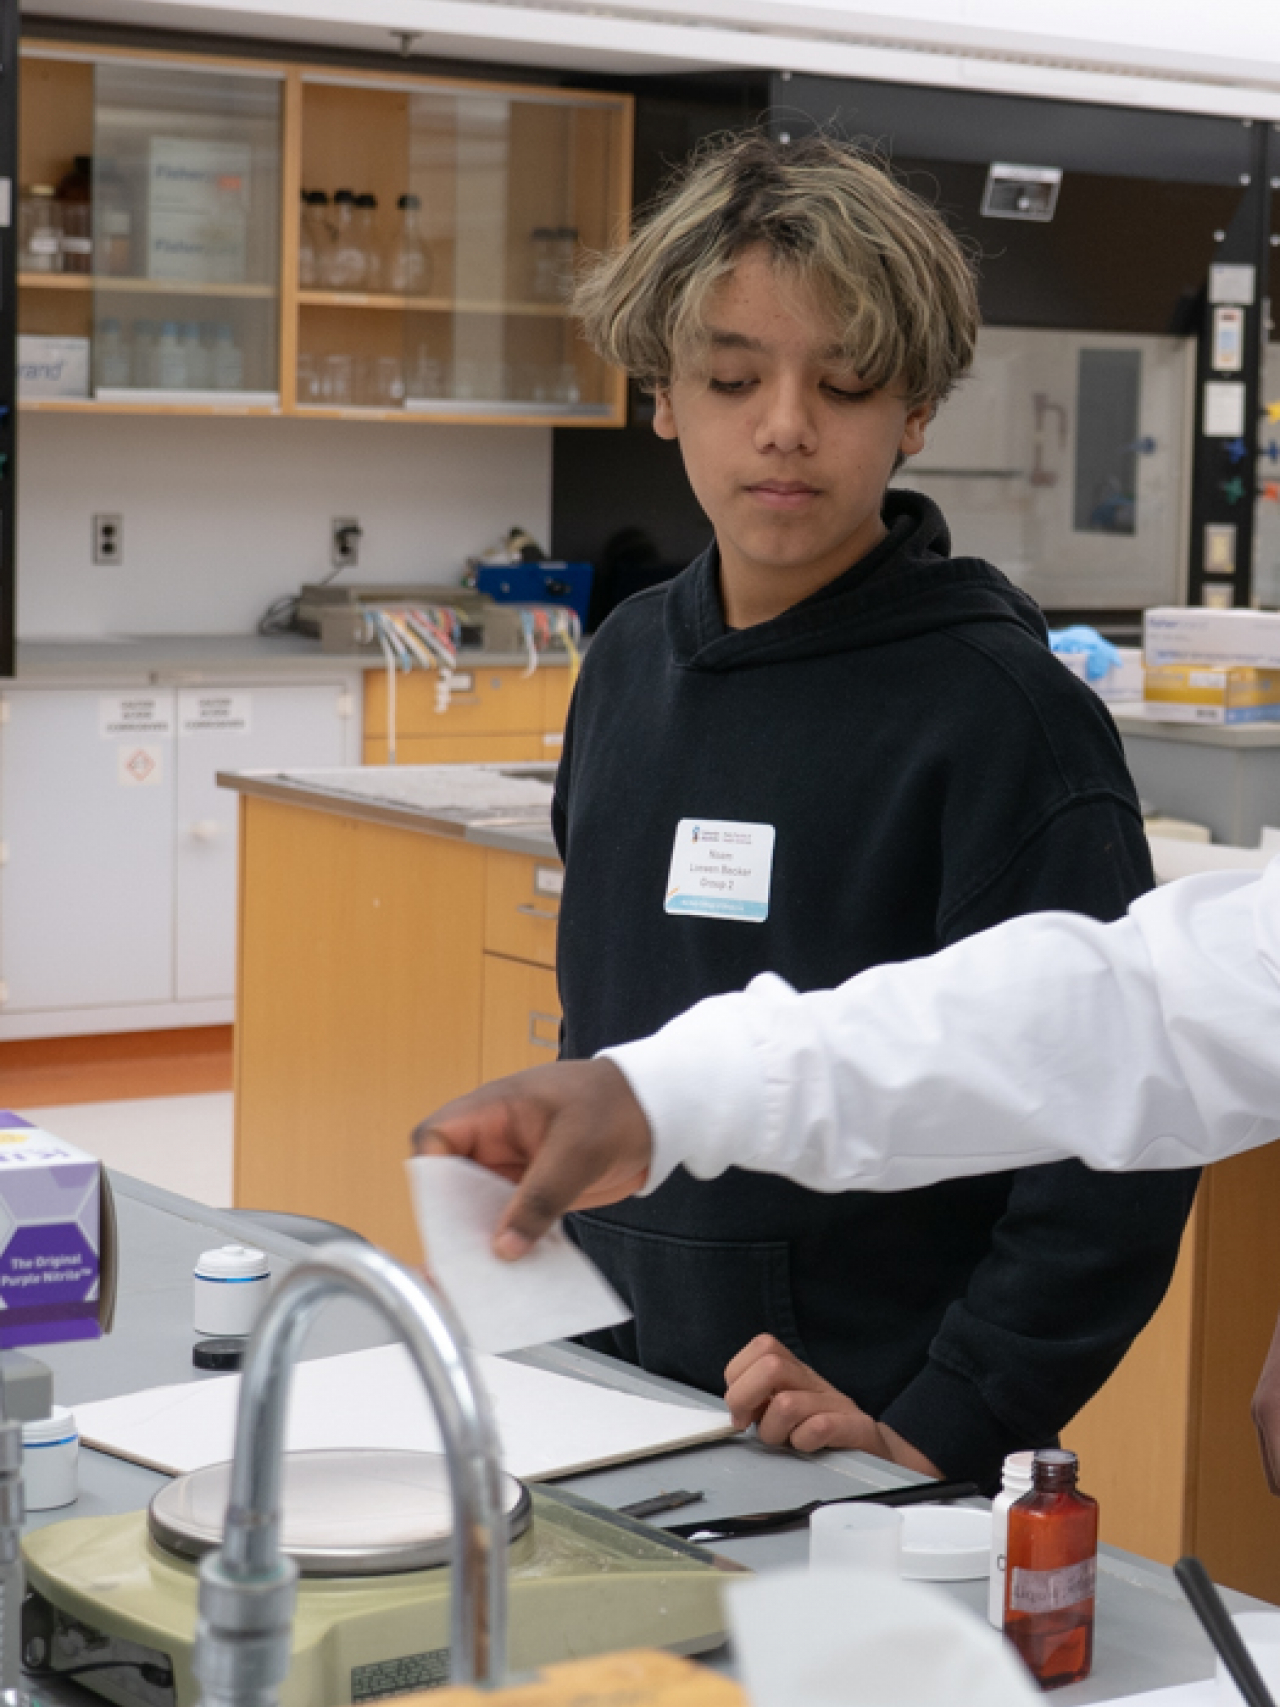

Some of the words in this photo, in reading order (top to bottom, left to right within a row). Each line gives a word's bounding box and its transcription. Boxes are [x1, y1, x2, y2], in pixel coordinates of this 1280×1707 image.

[11, 1257, 33, 1270] The
[36, 1253, 82, 1269] Original
[1, 1274, 40, 1288] Purple
